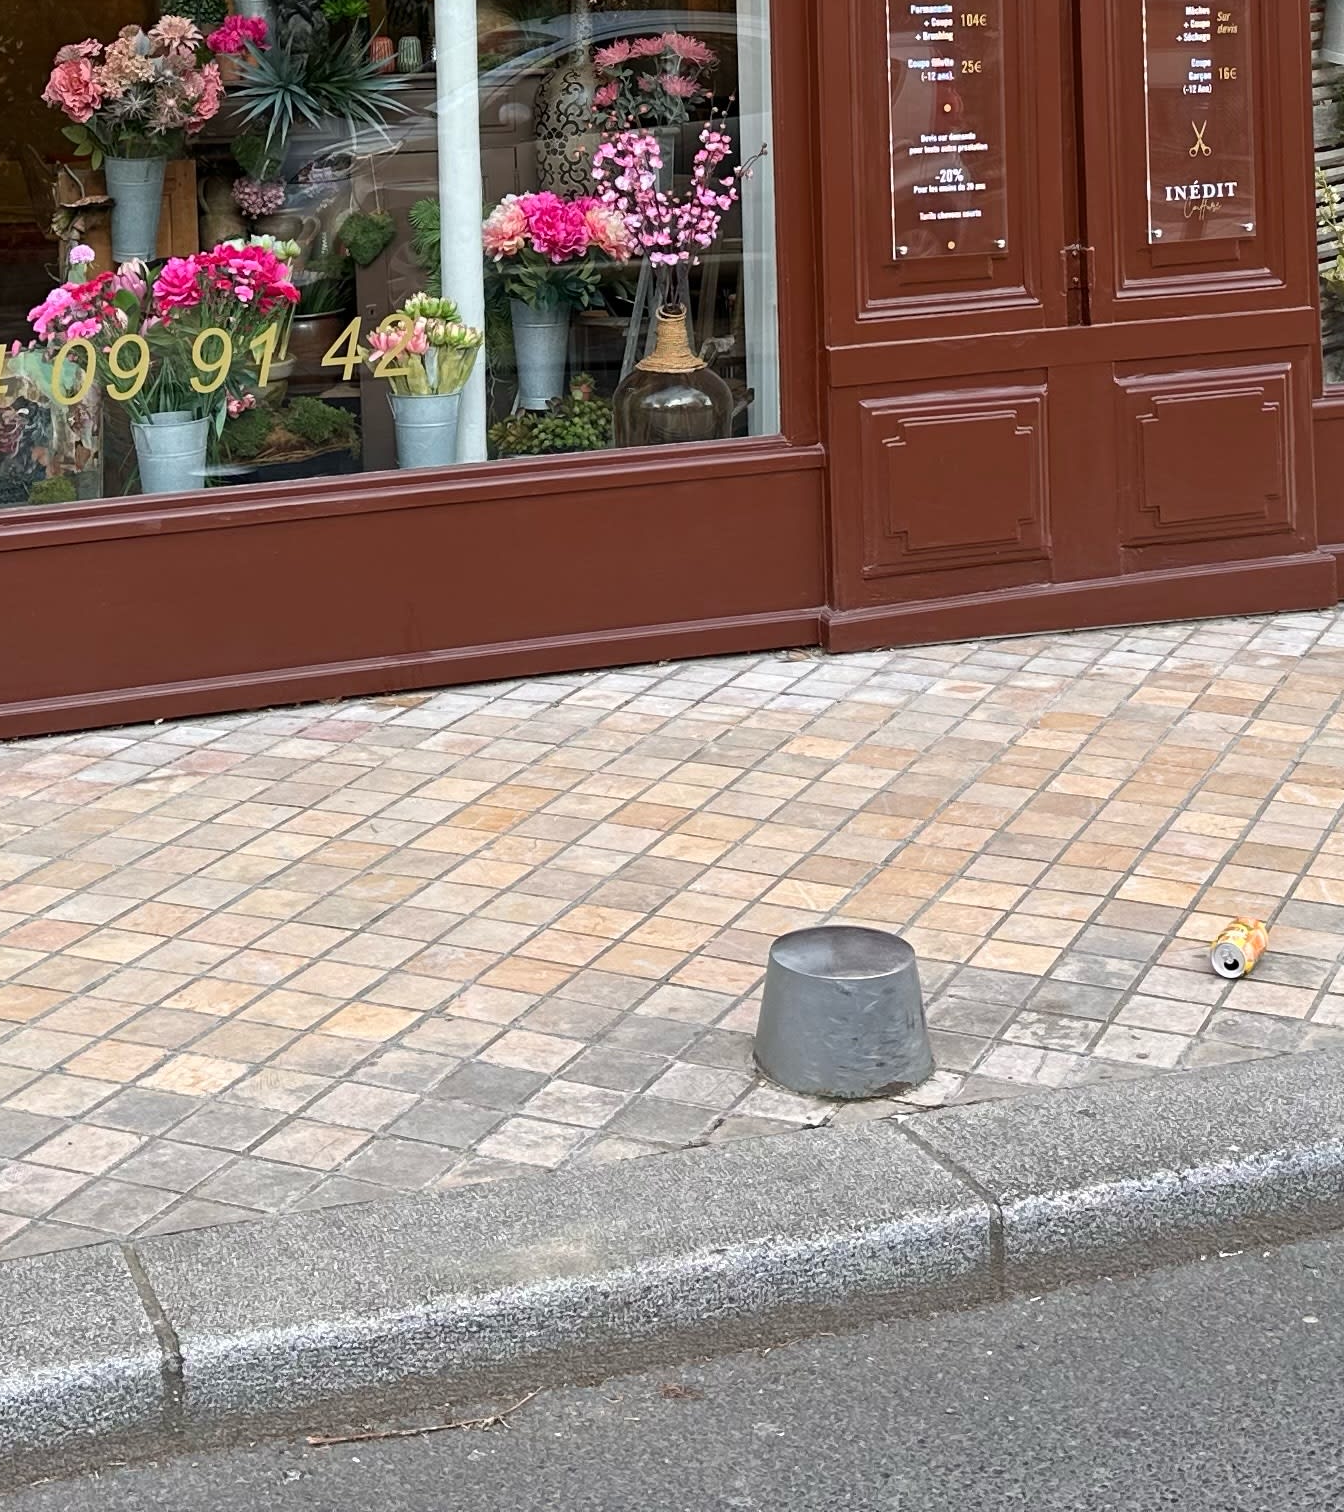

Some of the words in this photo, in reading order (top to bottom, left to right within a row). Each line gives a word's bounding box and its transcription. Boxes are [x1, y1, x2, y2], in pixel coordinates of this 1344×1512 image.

[960, 14, 987, 27] 104€
[961, 60, 982, 73] 25€
[1218, 67, 1237, 80] 16€
[935, 168, 964, 183] -20%
[1165, 180, 1238, 202] INÉDIT
[50, 333, 151, 406] 09
[189, 322, 278, 394] 91
[320, 312, 416, 382] 42
